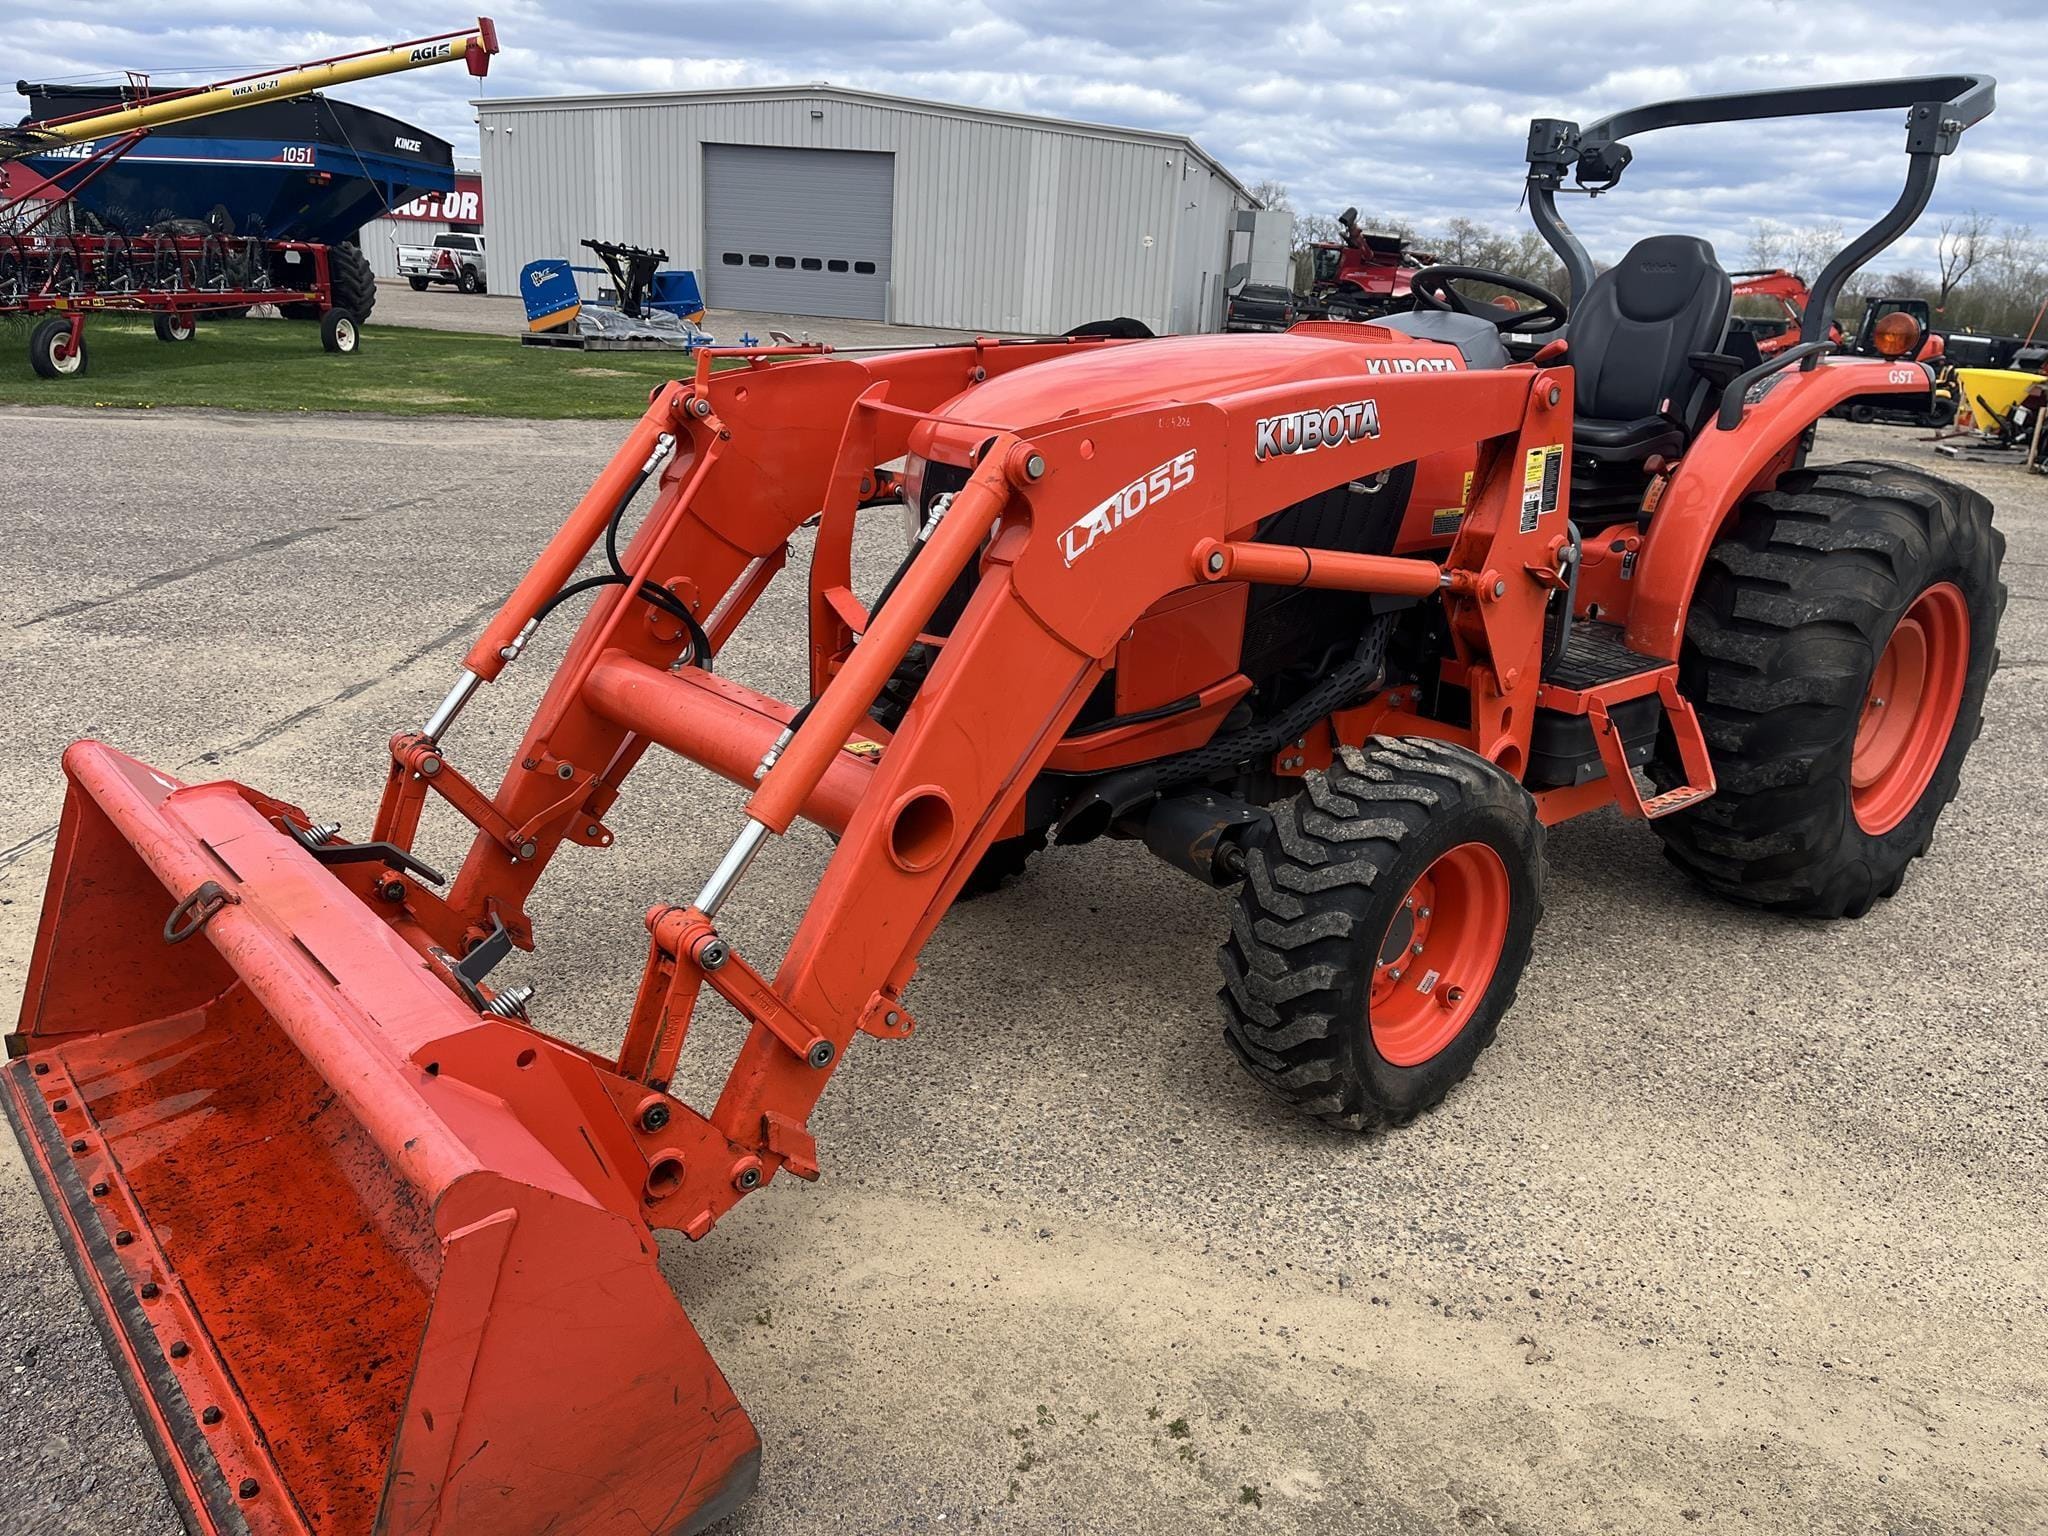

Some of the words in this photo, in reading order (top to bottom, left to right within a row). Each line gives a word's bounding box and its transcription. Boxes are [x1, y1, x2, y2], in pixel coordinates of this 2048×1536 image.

[410, 45, 437, 61] AGI
[232, 85, 253, 96] WRX
[256, 79, 279, 91] 10-71
[394, 136, 421, 152] KINZE
[282, 146, 311, 163] 1051
[1889, 370, 1914, 384] GST
[1256, 400, 1380, 460] KUBOTA
[1065, 450, 1196, 562] LA1055
